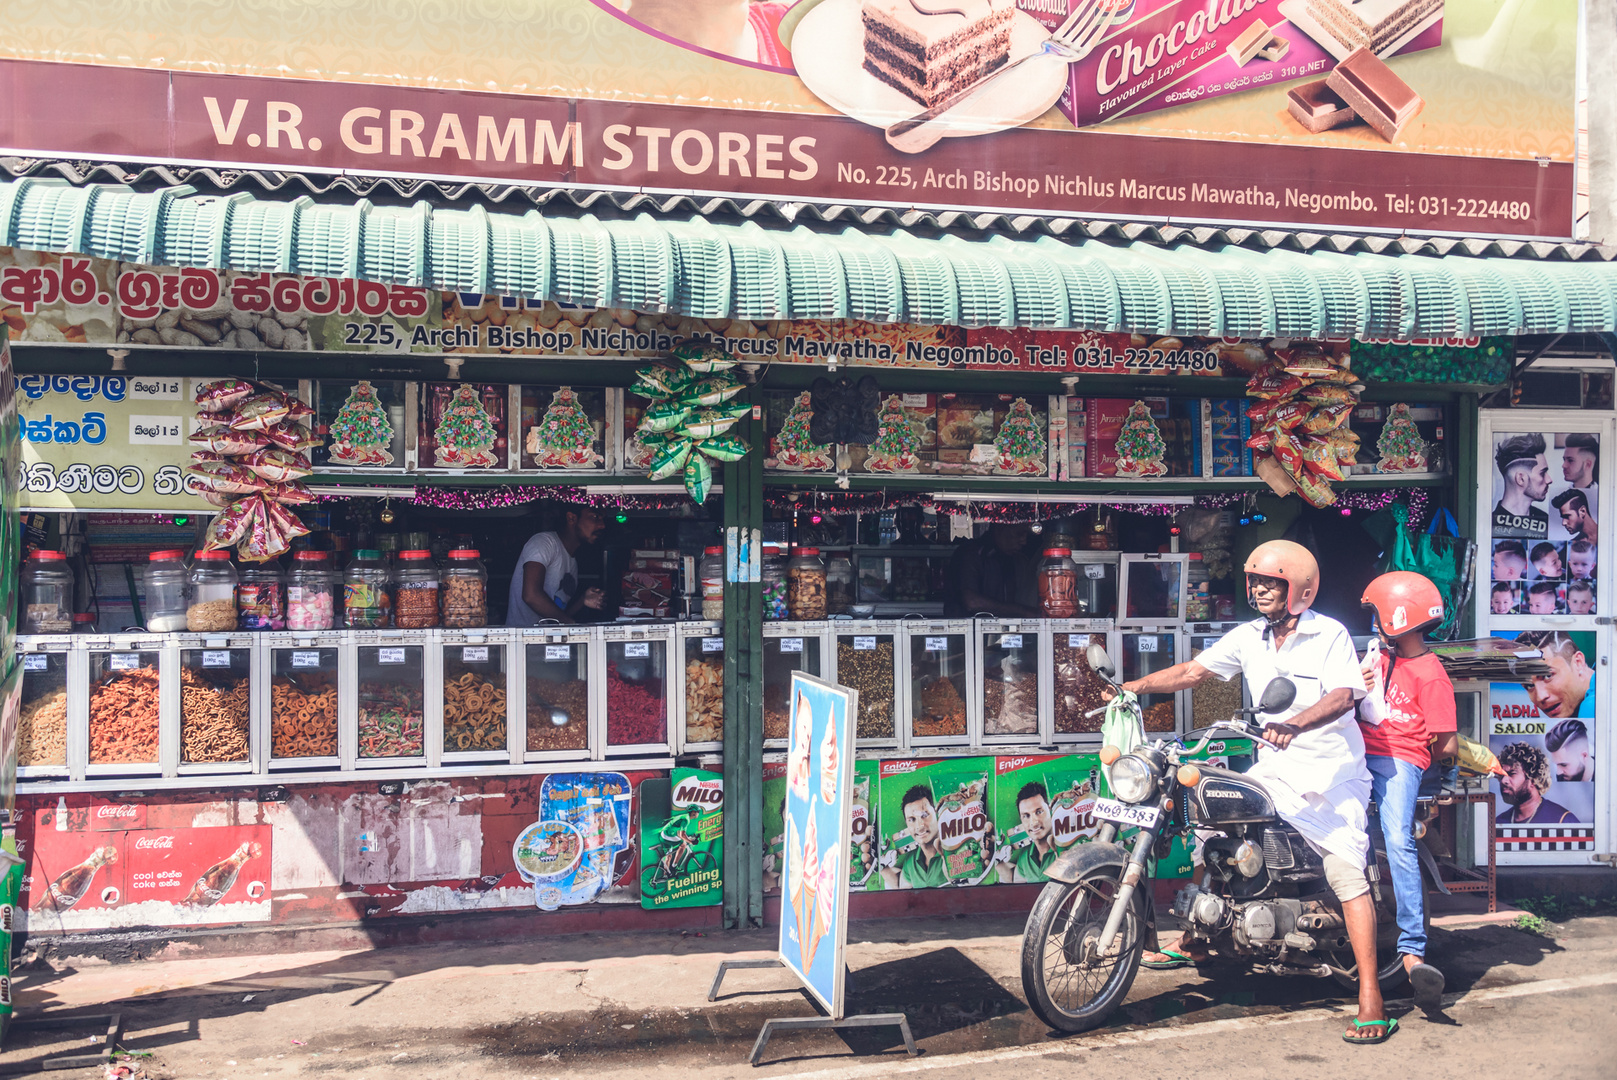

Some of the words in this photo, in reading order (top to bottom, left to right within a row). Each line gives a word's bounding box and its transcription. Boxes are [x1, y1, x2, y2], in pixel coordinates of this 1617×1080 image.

[1099, 74, 1154, 114] Flavoured
[1157, 54, 1188, 81] Layer
[1190, 40, 1216, 61] Cake
[1281, 66, 1296, 78] 310
[1300, 60, 1326, 76] g.NET
[203, 96, 322, 151] V.R.
[340, 106, 584, 168] GRAMM
[602, 124, 819, 181] STORES
[838, 162, 870, 184] No.
[876, 166, 918, 190] 225,
[922, 167, 968, 190] Arch
[974, 170, 1040, 198] Bishop
[1045, 174, 1114, 198] Nichlus
[1120, 178, 1186, 202] Marcus
[1191, 182, 1280, 209] Mawatha,
[1285, 188, 1378, 214] Negombo.
[1385, 194, 1414, 214] Tel:
[1418, 196, 1530, 220] 031-2224480
[344, 324, 402, 350] 225,
[412, 324, 479, 348] Archi
[488, 327, 573, 353] Bishop
[784, 336, 898, 363] Mawatha,
[906, 342, 1020, 367] Negombo.
[1026, 345, 1066, 366] Tel:
[1074, 346, 1218, 372] 031-2224480
[1496, 514, 1546, 532] CLOSED
[1140, 643, 1155, 651] 50/-
[1492, 704, 1540, 720] RADHA
[1494, 723, 1546, 734] SALON
[1209, 744, 1224, 755] MILO
[999, 757, 1034, 770] Enjoy...
[676, 786, 723, 804] MILO
[1206, 790, 1243, 798] HONDA
[97, 804, 138, 818] Coca-Cola
[941, 814, 986, 840] MILO
[136, 836, 175, 850] Coca-Cola
[133, 872, 154, 880] cool
[1178, 865, 1191, 874] the
[133, 880, 156, 888] coke
[667, 868, 720, 891] Fuelling
[654, 895, 670, 905] the
[672, 883, 709, 900] winning
[3, 906, 12, 931] MILO
